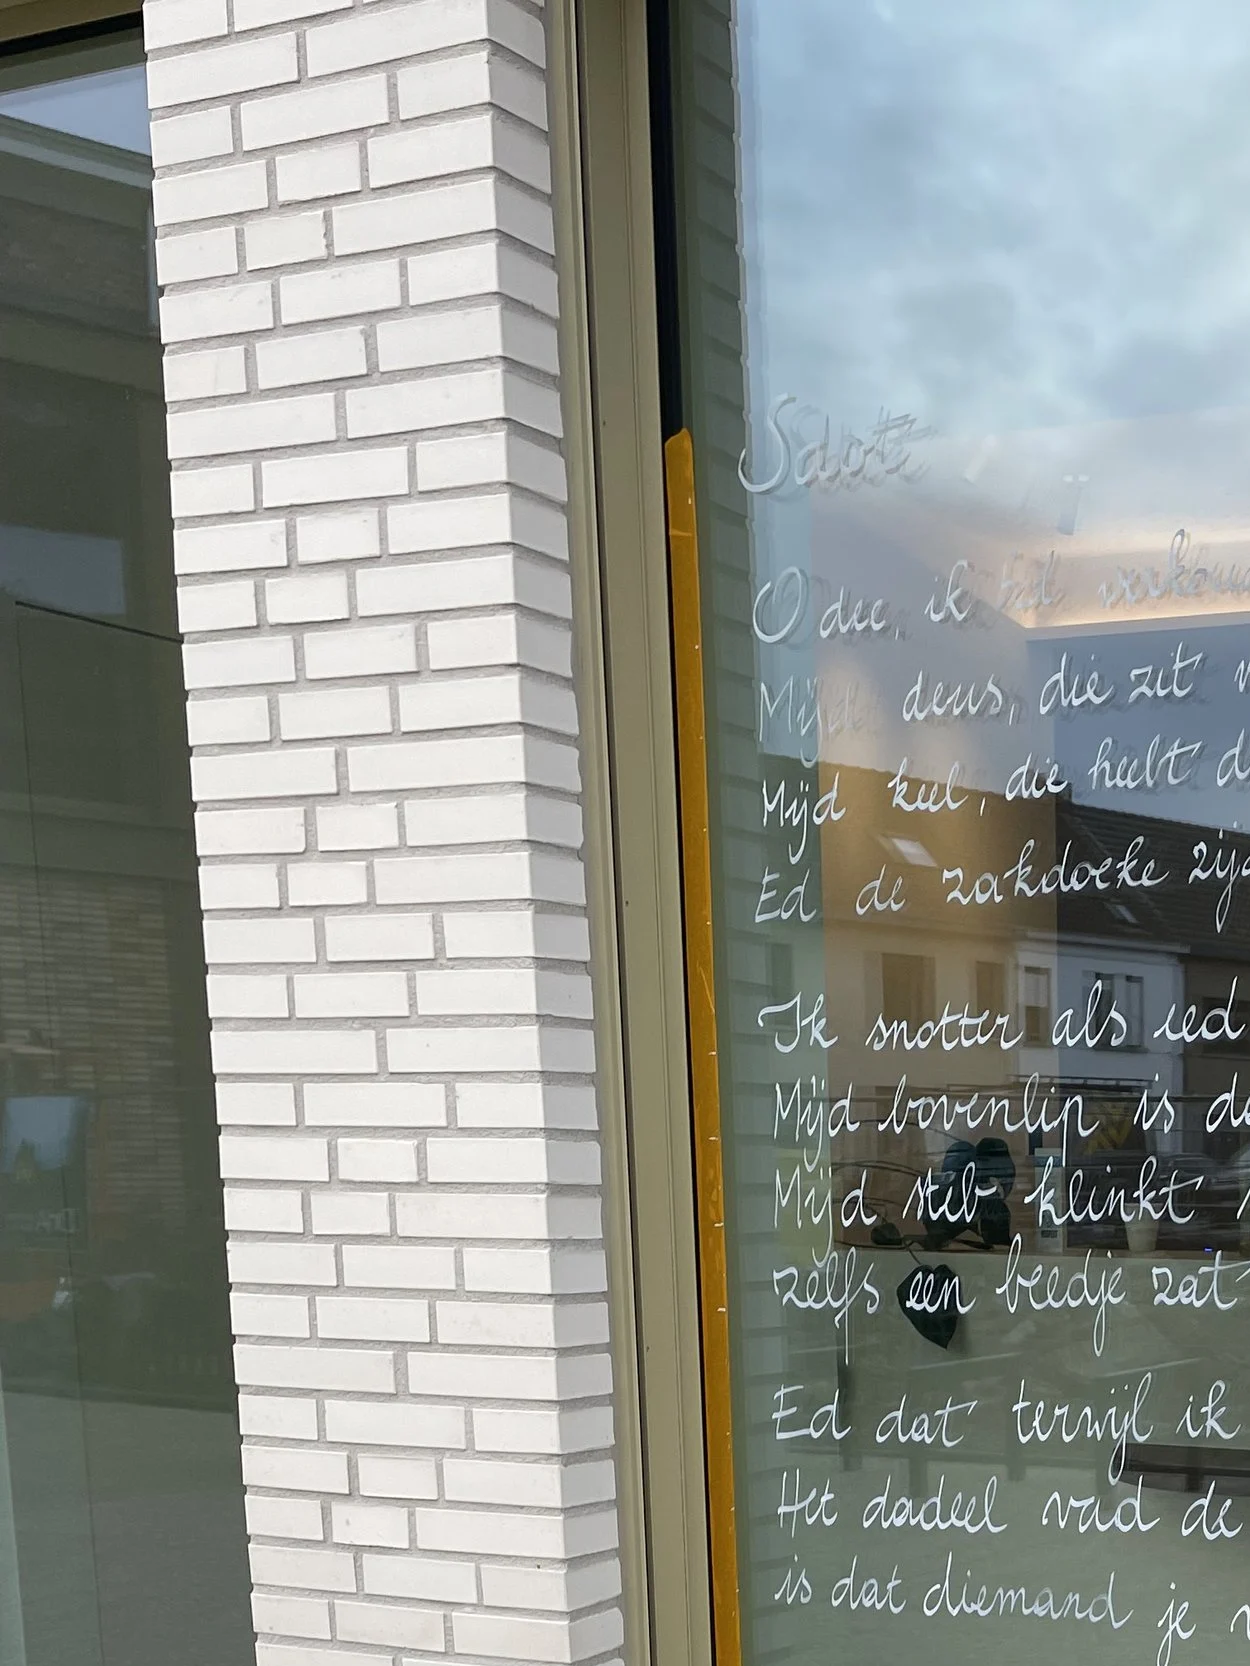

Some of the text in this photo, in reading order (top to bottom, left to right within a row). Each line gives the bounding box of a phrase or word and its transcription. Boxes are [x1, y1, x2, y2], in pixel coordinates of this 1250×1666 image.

[753, 566, 808, 643] O
[819, 586, 900, 640] dee,
[924, 559, 972, 622] ik
[902, 670, 1017, 725] deus,
[1039, 652, 1114, 715] die
[1128, 641, 1203, 703] zit
[762, 771, 847, 865] Mijd
[1005, 752, 1068, 802] die
[755, 866, 817, 923] Ed
[855, 864, 906, 916] de
[942, 835, 1170, 906] zakdoeke
[757, 992, 838, 1054] Ik
[865, 1001, 1024, 1052] snotter
[1051, 979, 1127, 1047] als
[773, 1075, 861, 1173] Mijd
[877, 1072, 1100, 1168] bovenlip
[1133, 1073, 1176, 1134] is
[774, 1163, 877, 1268] Mijd
[902, 1161, 1002, 1224] steb
[1024, 1155, 1205, 1227] klinkt
[773, 1246, 880, 1365] zelfs
[906, 1265, 977, 1315] een
[996, 1233, 1127, 1357] beedje
[771, 1383, 852, 1441] Ed
[875, 1394, 978, 1448] dat
[1012, 1371, 1155, 1486] terwijl
[1176, 1379, 1241, 1441] ik
[777, 1468, 839, 1539] Het
[862, 1475, 1008, 1533] dadeel
[1041, 1475, 1160, 1533] vad
[1181, 1481, 1244, 1540] de
[774, 1553, 812, 1606] is
[831, 1555, 907, 1611] dat
[923, 1551, 1134, 1630] diemand
